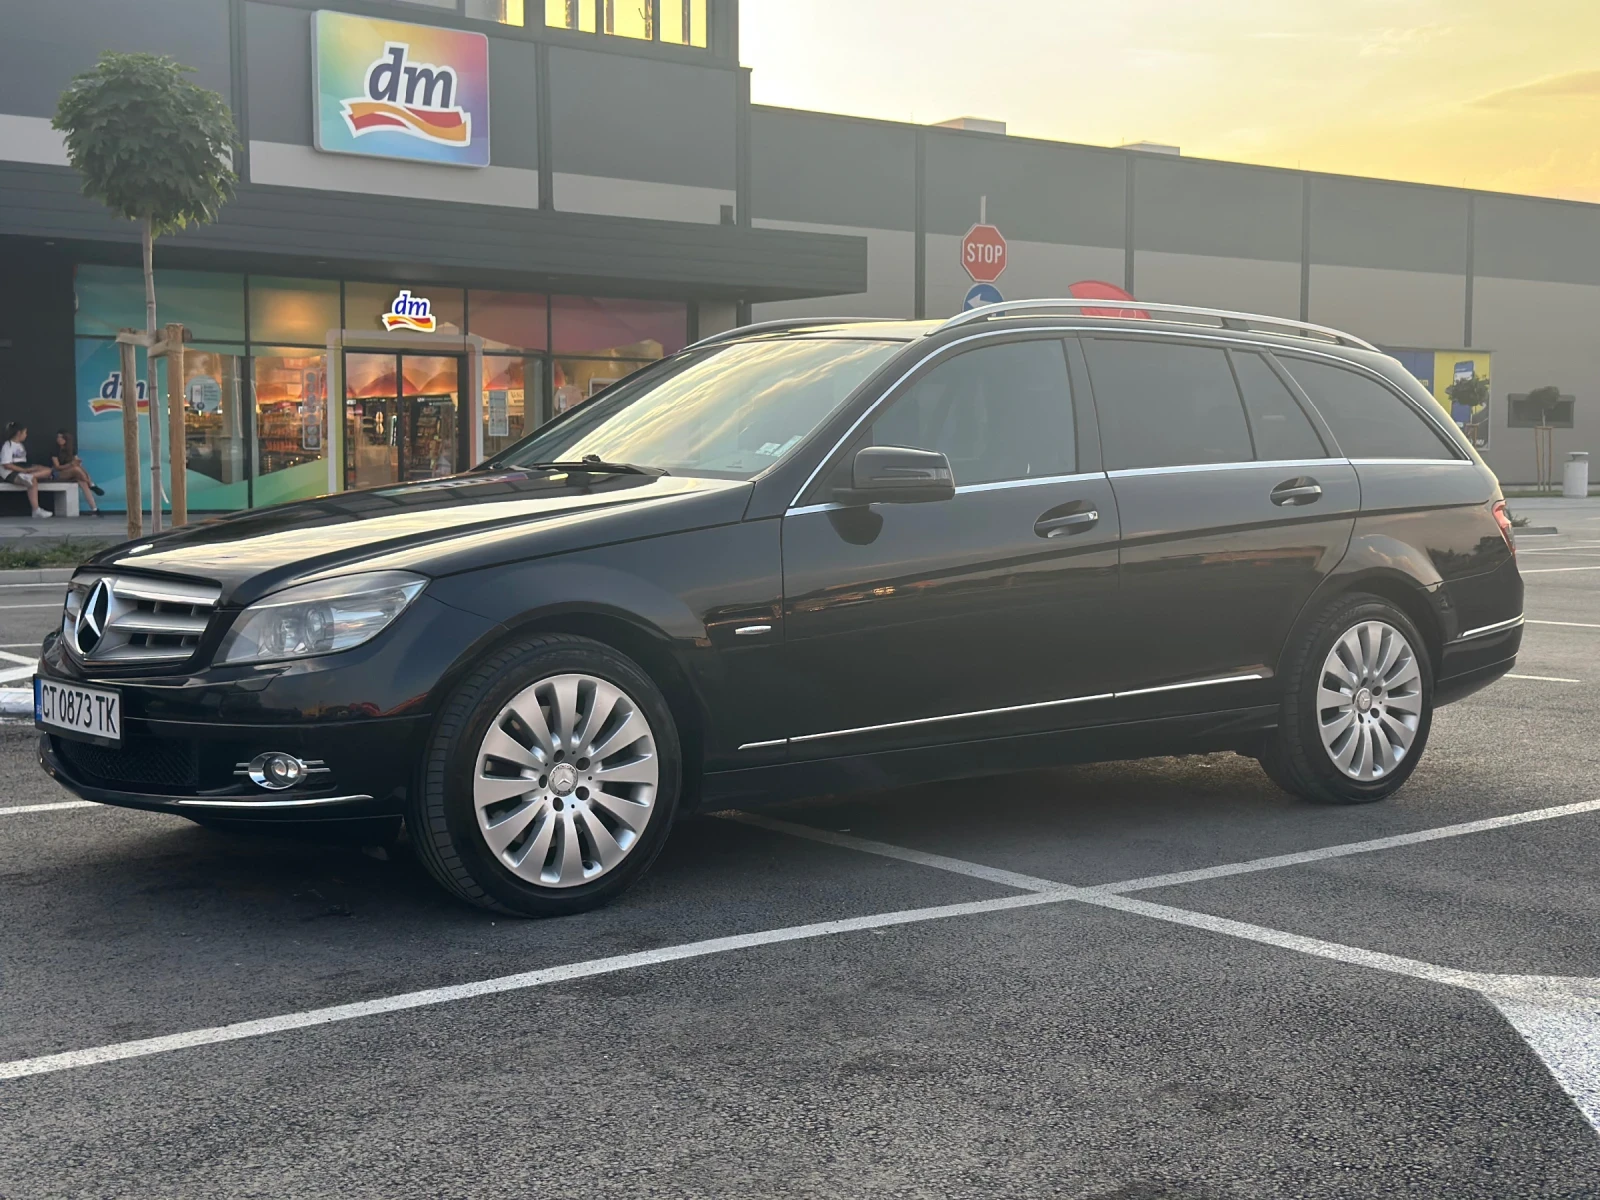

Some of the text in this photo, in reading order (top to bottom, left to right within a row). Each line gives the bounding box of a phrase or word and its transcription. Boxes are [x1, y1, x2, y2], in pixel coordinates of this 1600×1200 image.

[369, 47, 453, 109] dm
[967, 242, 1003, 264] STOP
[394, 293, 428, 317] dm
[42, 684, 117, 734] CT 0873 TK
